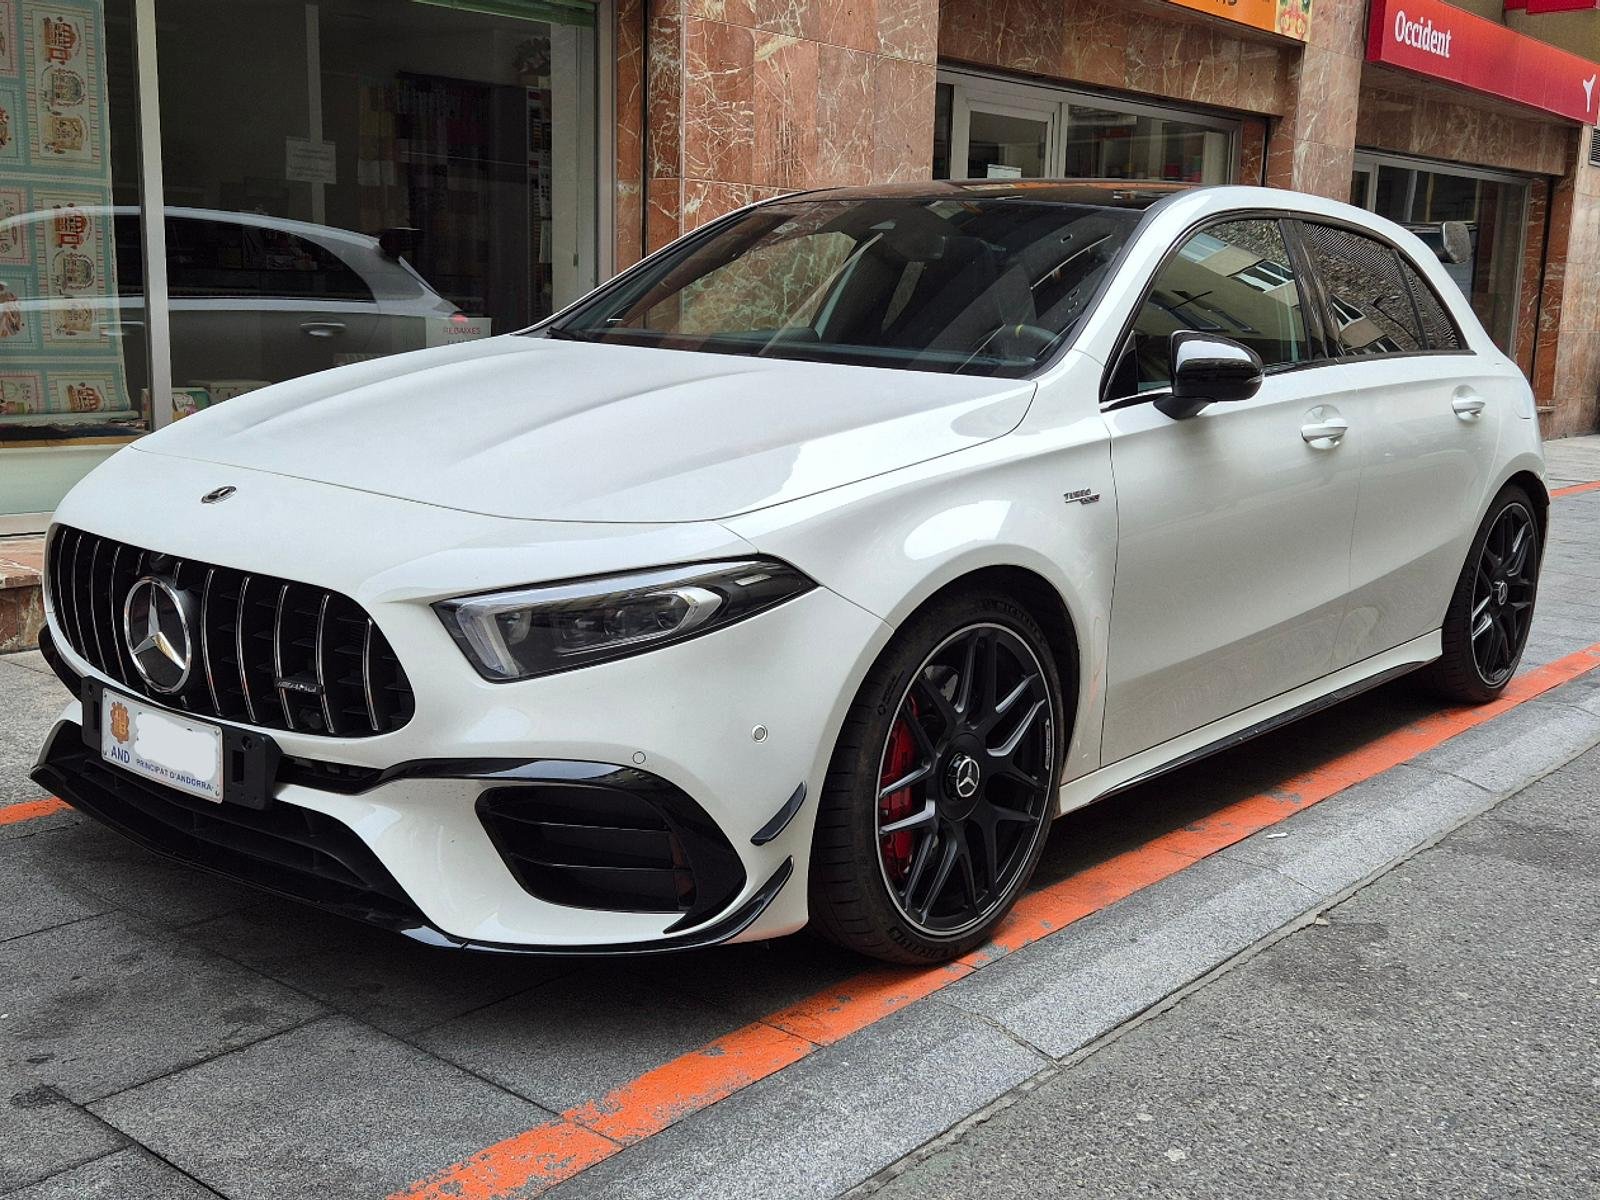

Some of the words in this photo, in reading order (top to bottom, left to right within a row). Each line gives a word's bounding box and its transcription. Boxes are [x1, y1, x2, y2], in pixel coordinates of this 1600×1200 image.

[1395, 10, 1451, 58] Occident
[111, 746, 130, 764] AND
[136, 758, 168, 775] PRINCIPAT
